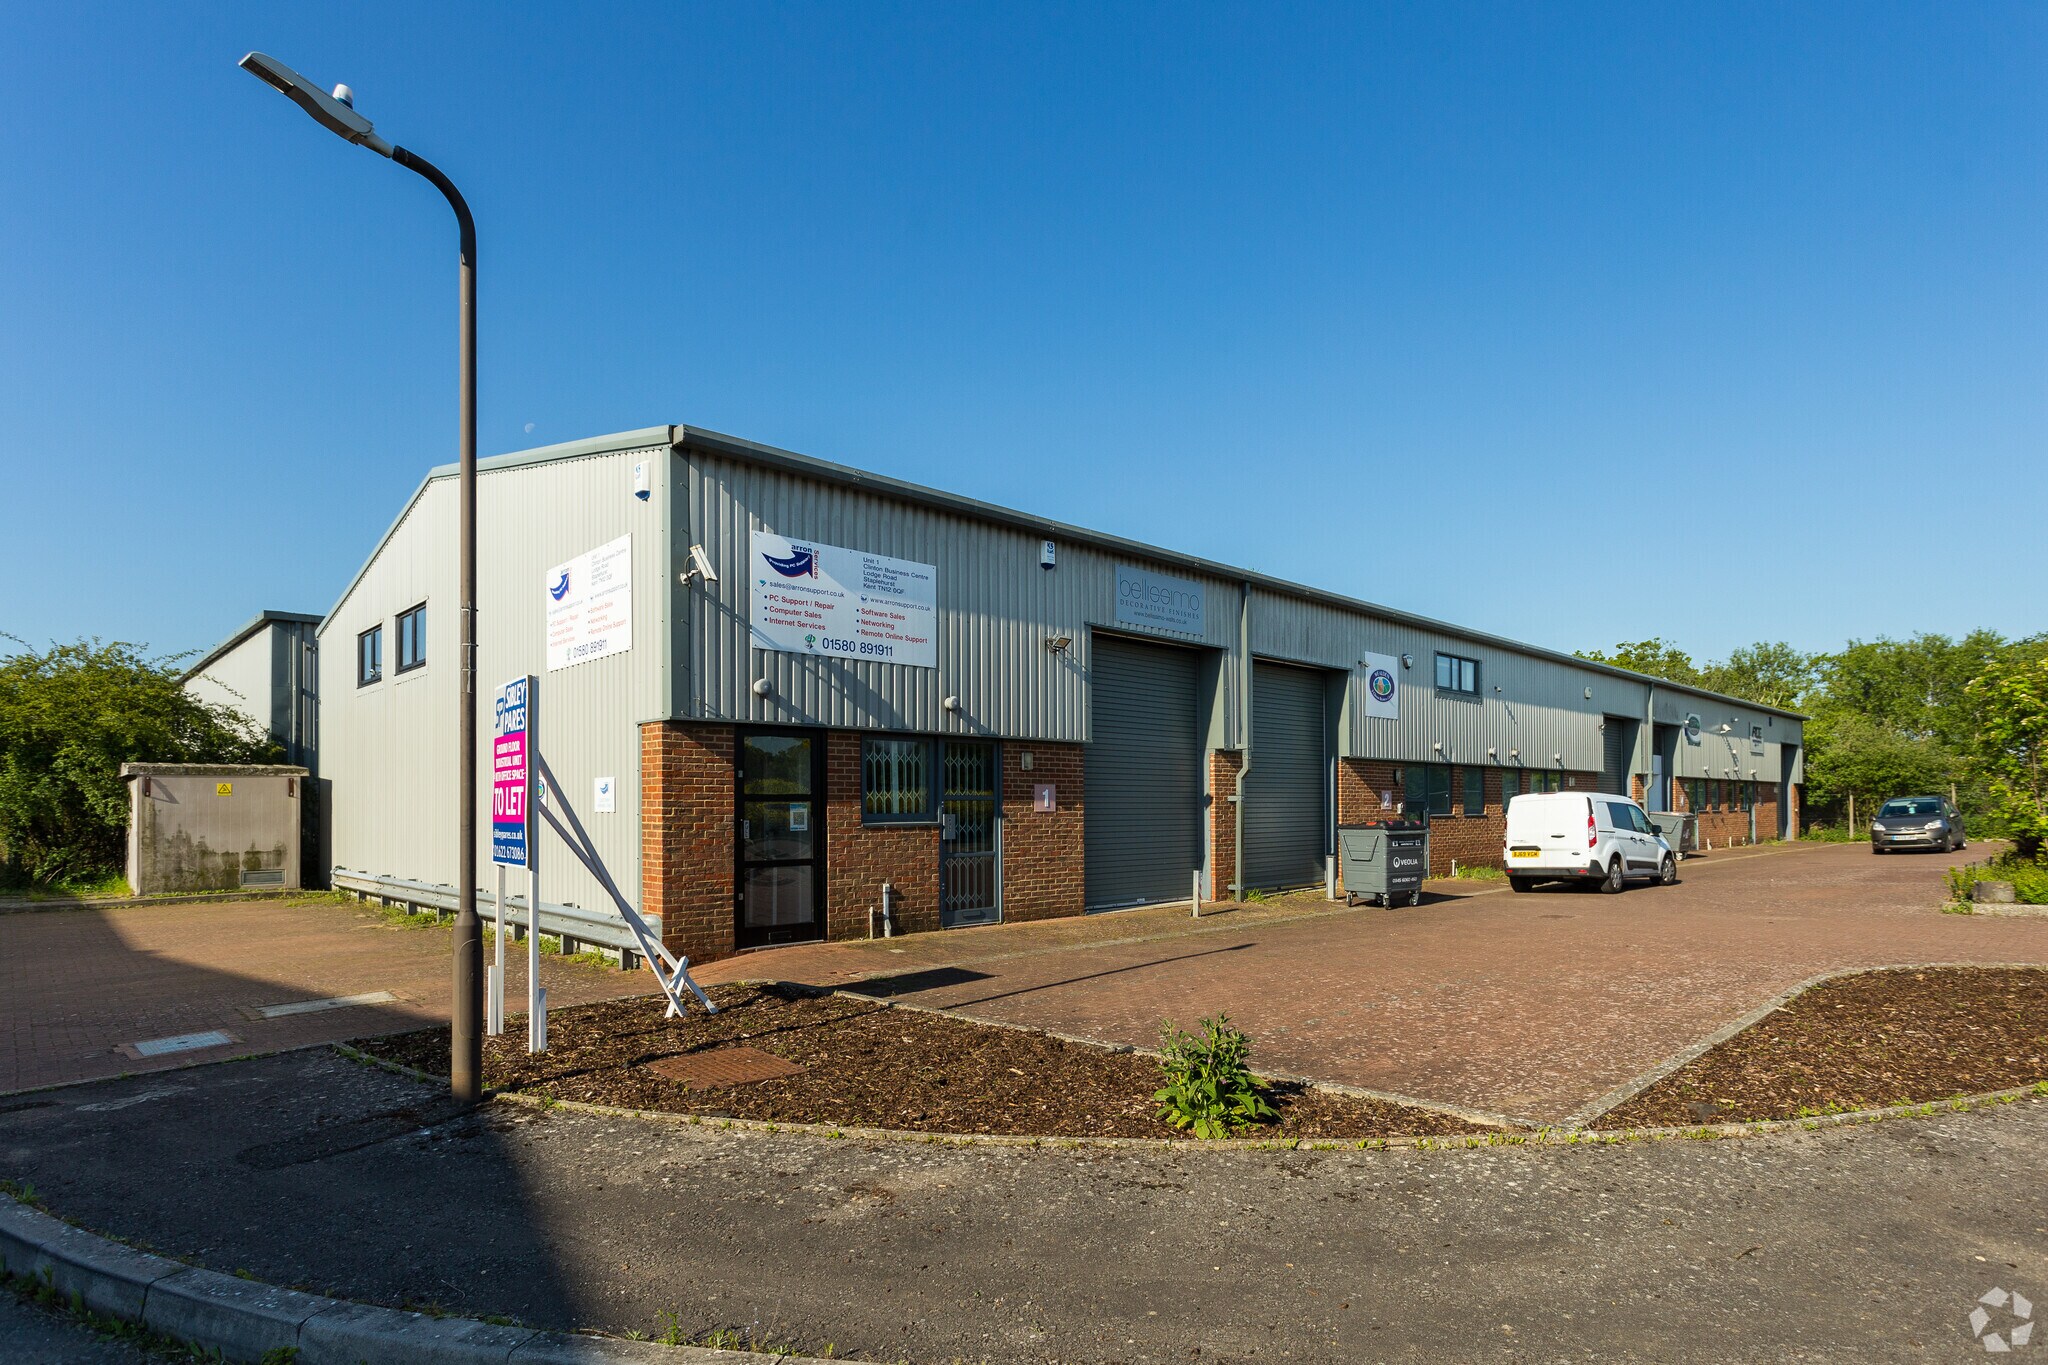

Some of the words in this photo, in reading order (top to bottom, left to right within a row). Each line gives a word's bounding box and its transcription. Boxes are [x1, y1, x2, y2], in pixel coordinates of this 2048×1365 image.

[792, 544, 812, 553] arron
[863, 564, 883, 572] Clinton
[884, 567, 909, 576] Business
[863, 576, 895, 587] Staplehurst
[769, 581, 845, 598] sales@arronsupport.co.uk
[1120, 573, 1199, 610] bellissimo
[781, 596, 808, 607] Support
[815, 601, 834, 610] Repair
[870, 597, 931, 612] www.arronsupport.co.uk
[1120, 599, 1165, 613] DECORATIVE
[1169, 609, 1199, 619] FINISHES
[769, 606, 802, 618] Computer
[804, 610, 822, 619] Sales
[861, 608, 888, 619] Software
[890, 612, 905, 620] Sales
[769, 617, 795, 627] Internet
[797, 620, 826, 630] Services
[861, 619, 895, 630] Networking
[861, 629, 883, 638] Remote
[885, 632, 903, 641] Online
[905, 635, 928, 644] Support
[573, 643, 589, 658] 01580
[590, 640, 607, 653] 891911
[822, 637, 856, 652] 01580
[860, 642, 893, 656] 891911
[506, 682, 525, 708] SIBLEY
[505, 707, 525, 732] PARES
[512, 754, 522, 766] UNIT
[512, 769, 524, 780] SPACE
[494, 787, 504, 816] TO
[506, 786, 524, 815] LET
[1042, 789, 1049, 807] 1
[1384, 794, 1390, 806] 2
[494, 845, 506, 858] 01622
